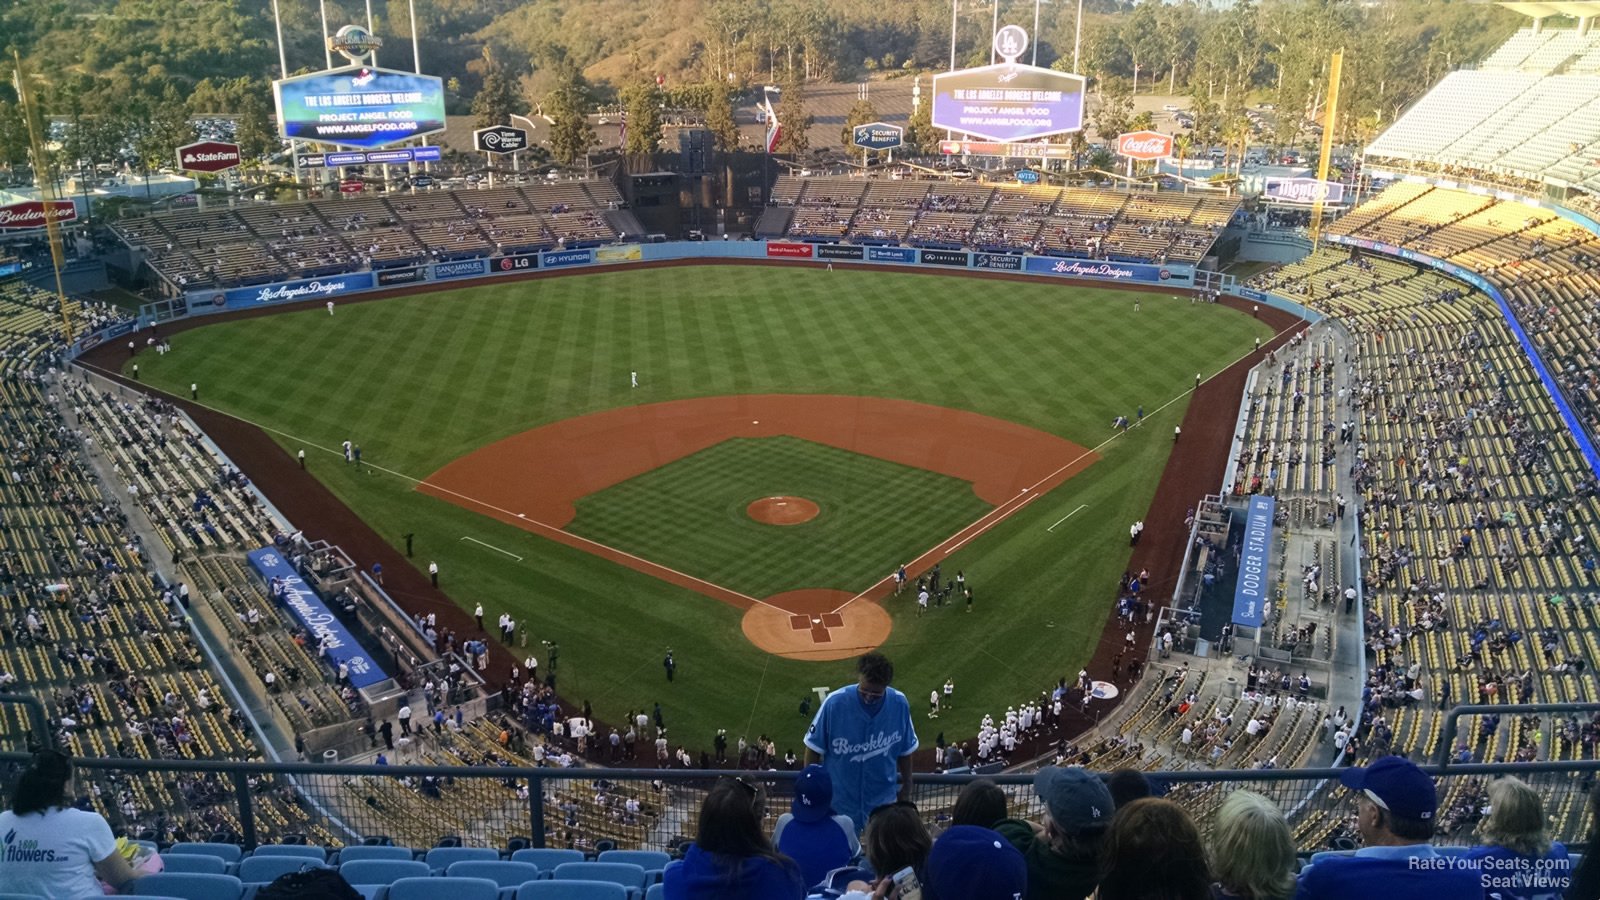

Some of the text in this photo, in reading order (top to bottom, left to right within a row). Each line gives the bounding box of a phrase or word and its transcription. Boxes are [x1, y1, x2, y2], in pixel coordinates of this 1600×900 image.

[304, 92, 423, 107] THE LOS ANGELES DODGERS WELCOME
[954, 89, 965, 99] THE
[1032, 90, 1062, 101] WELCOME
[319, 110, 414, 122] PROJECT ANGEL FOOD
[963, 106, 1050, 115] PROJECT ANGEL FOOD
[960, 117, 1052, 127] WWW.ANGELFOOD.ORG
[316, 122, 418, 135] WWW.ANGELFOOD.ORG
[1279, 180, 1330, 198] Monteo
[515, 258, 529, 268] LG
[558, 253, 590, 262] HYUNDAI
[990, 255, 1018, 263] SECURITY
[436, 265, 449, 273] SAN
[1052, 261, 1133, 278] Los Angeles Dodgers
[256, 281, 345, 301] Los Angeles Dodgers
[1249, 515, 1266, 552] STADIUM
[1243, 555, 1262, 596] DODGER
[832, 730, 902, 757] Brooklyn
